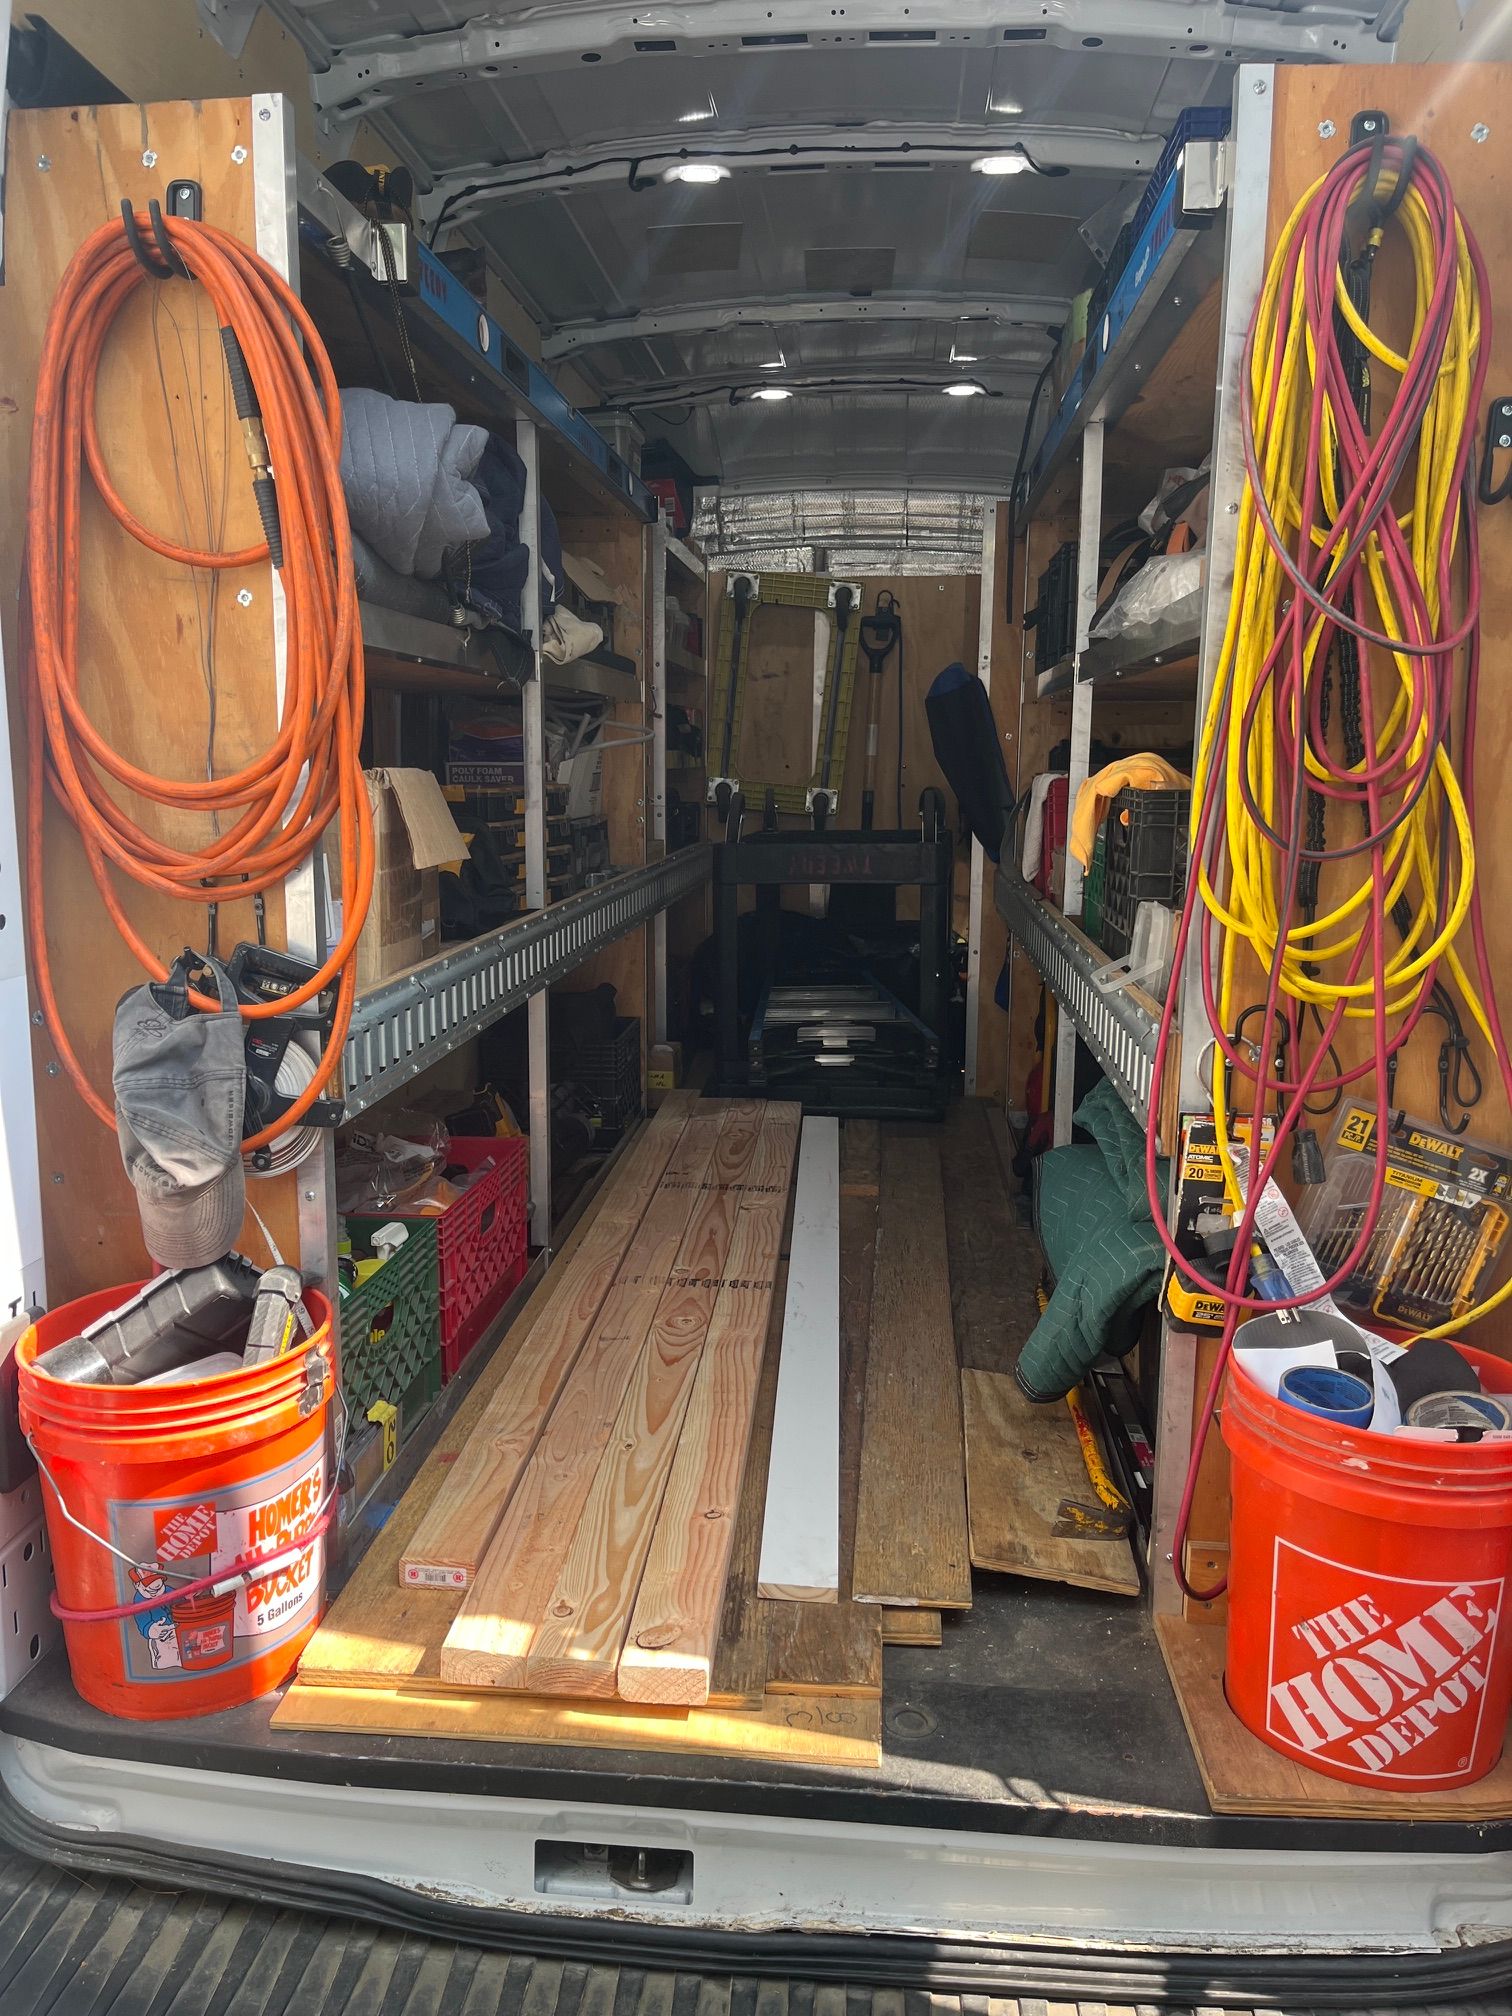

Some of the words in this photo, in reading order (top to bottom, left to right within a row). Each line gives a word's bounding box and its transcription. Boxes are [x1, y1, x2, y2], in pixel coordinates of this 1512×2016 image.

[452, 767, 475, 775] POLY
[477, 767, 503, 775] FOAM
[452, 775, 483, 783] CAULK
[484, 775, 514, 783] SAVER
[1346, 1115, 1370, 1136] 21
[1189, 1144, 1219, 1155] DEWA
[1188, 1167, 1204, 1179] 20
[1392, 1170, 1423, 1183] TITANIUM
[1467, 1167, 1490, 1183] 2X
[248, 1467, 322, 1546] HOMER'S
[156, 1504, 216, 1563] HOME
[160, 1512, 188, 1537] THE
[179, 1520, 216, 1560] DEPOT
[247, 1546, 314, 1614] BUCKET
[257, 1614, 264, 1626] 5
[267, 1592, 303, 1622] Gallons
[1291, 1594, 1393, 1659] THE
[1270, 1584, 1497, 1752] HOME
[1348, 1655, 1488, 1772] DEPOT
